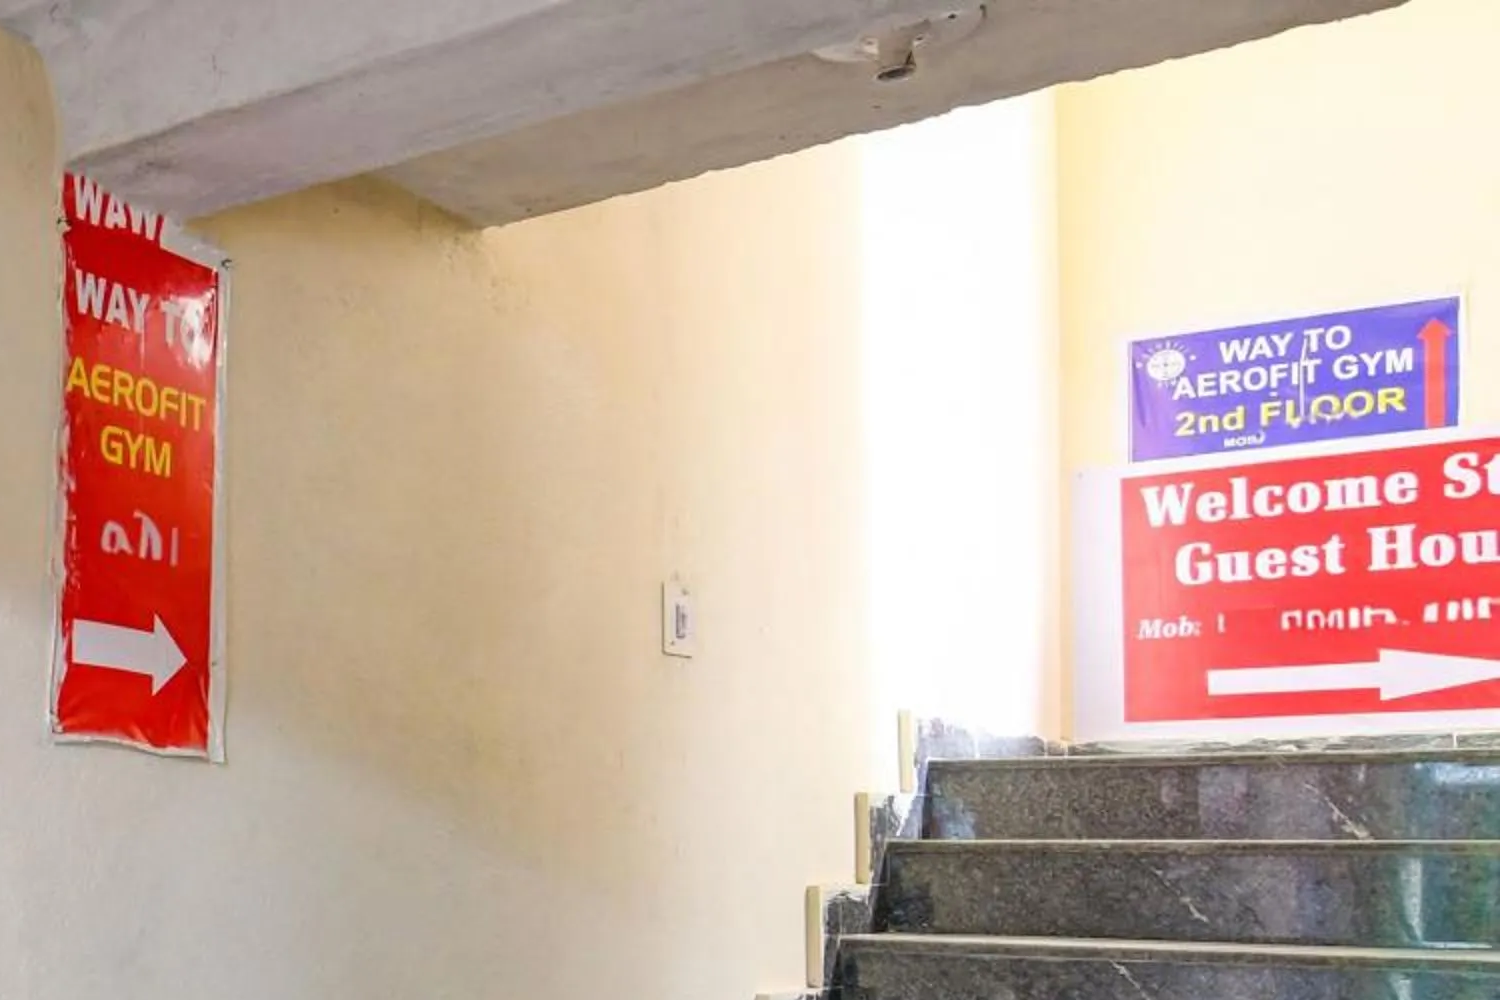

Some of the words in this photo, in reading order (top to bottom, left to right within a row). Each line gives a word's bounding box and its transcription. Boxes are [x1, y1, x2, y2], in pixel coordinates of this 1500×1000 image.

[74, 268, 150, 334] WAY
[1219, 332, 1293, 364] WAY
[1304, 325, 1352, 351] TO
[66, 357, 206, 431] AEROFIT
[1172, 359, 1321, 400] AEROFIT
[1333, 347, 1414, 380] GYM
[1174, 405, 1245, 436] 2nd
[101, 425, 172, 478] GYM
[1140, 471, 1419, 528] Welcome
[1175, 535, 1346, 585] Guest
[1366, 524, 1500, 571] Hou
